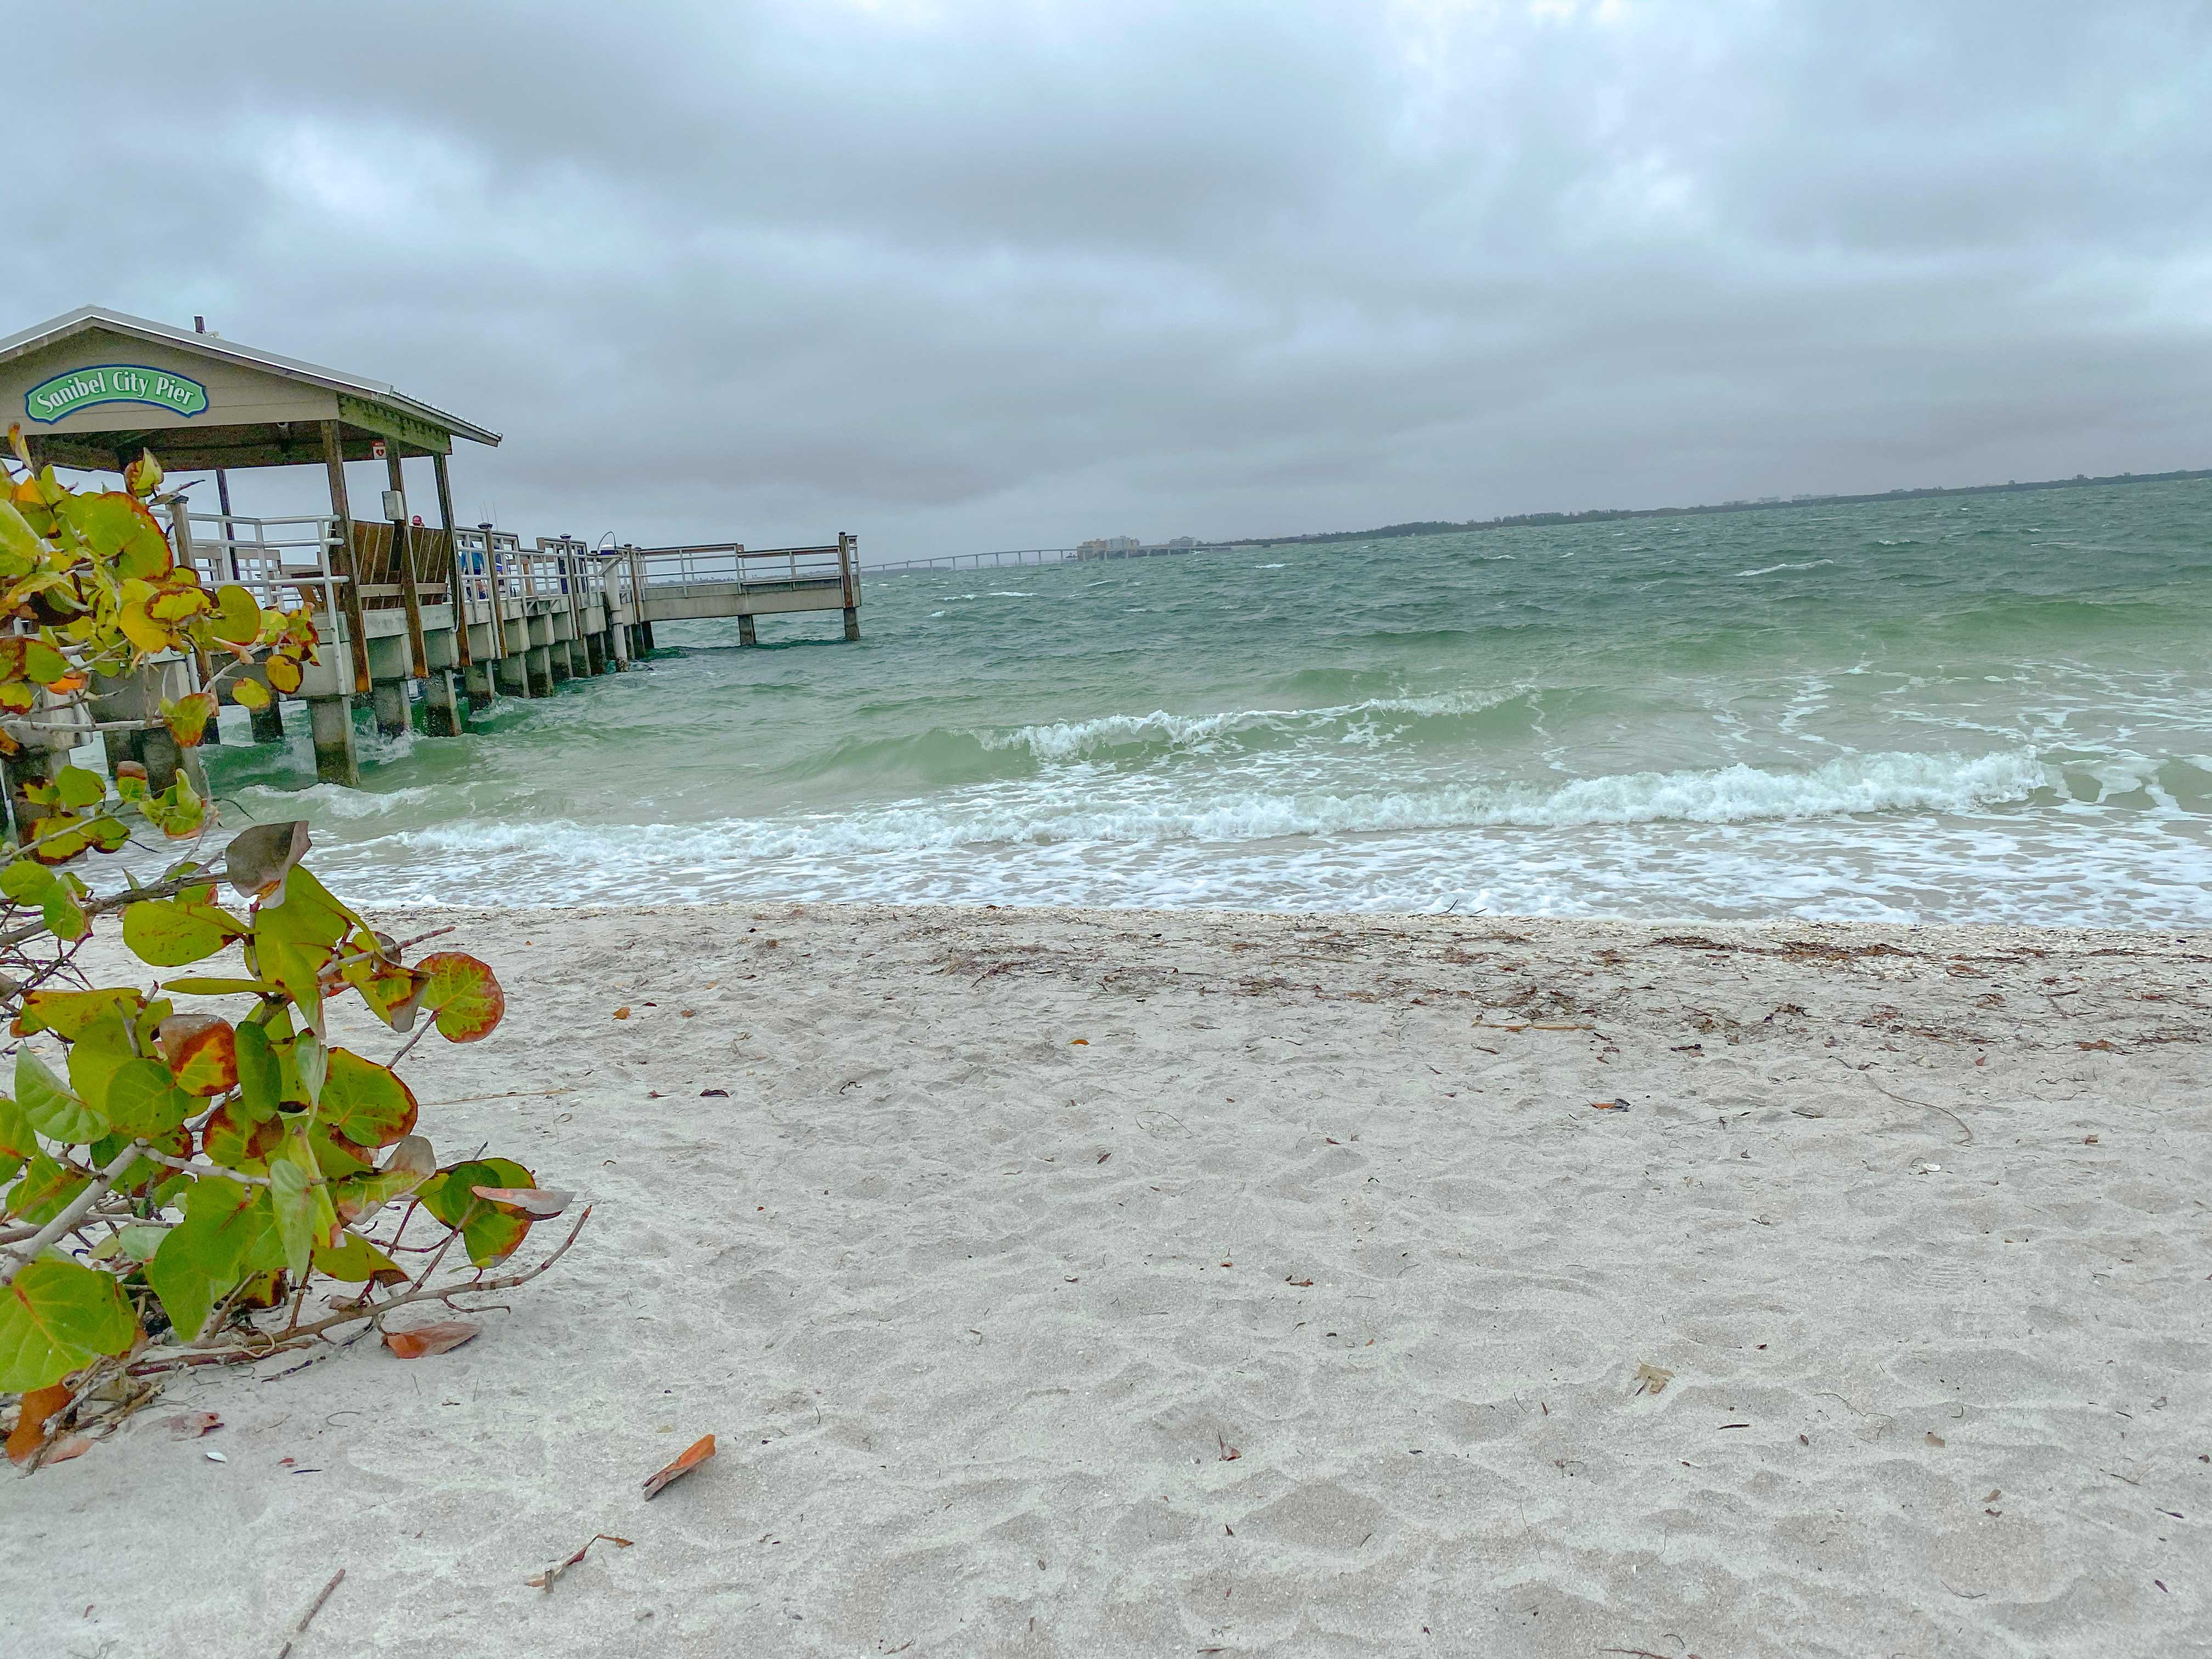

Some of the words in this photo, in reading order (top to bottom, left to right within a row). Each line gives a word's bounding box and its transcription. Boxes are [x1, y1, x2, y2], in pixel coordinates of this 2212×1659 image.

[37, 372, 106, 413] Sanibel
[112, 371, 149, 397] City
[156, 376, 194, 405] Pier
